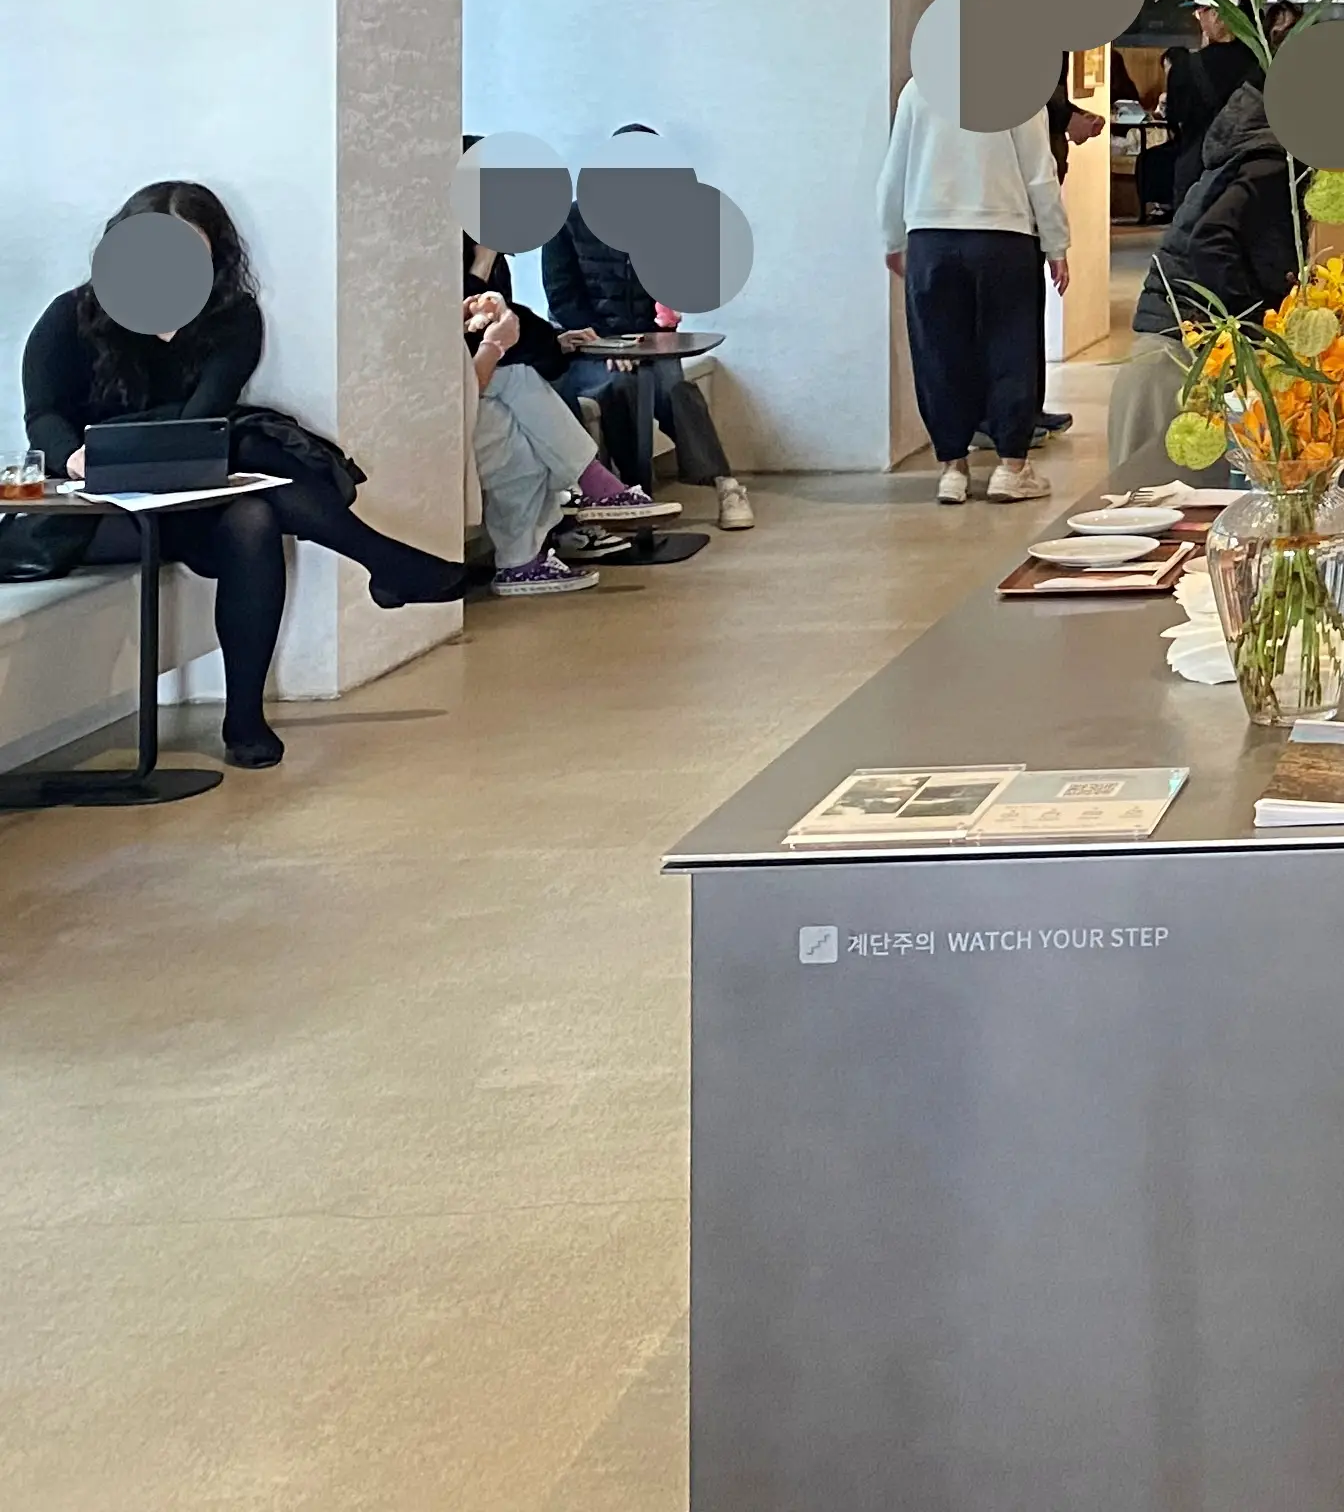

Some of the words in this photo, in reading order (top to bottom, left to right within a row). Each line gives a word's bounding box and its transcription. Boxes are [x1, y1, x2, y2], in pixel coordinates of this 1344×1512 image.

[846, 931, 935, 956] 계단주의
[947, 930, 1032, 953] WATCH
[1037, 928, 1105, 950] YOUR
[1108, 926, 1170, 949] STEP
